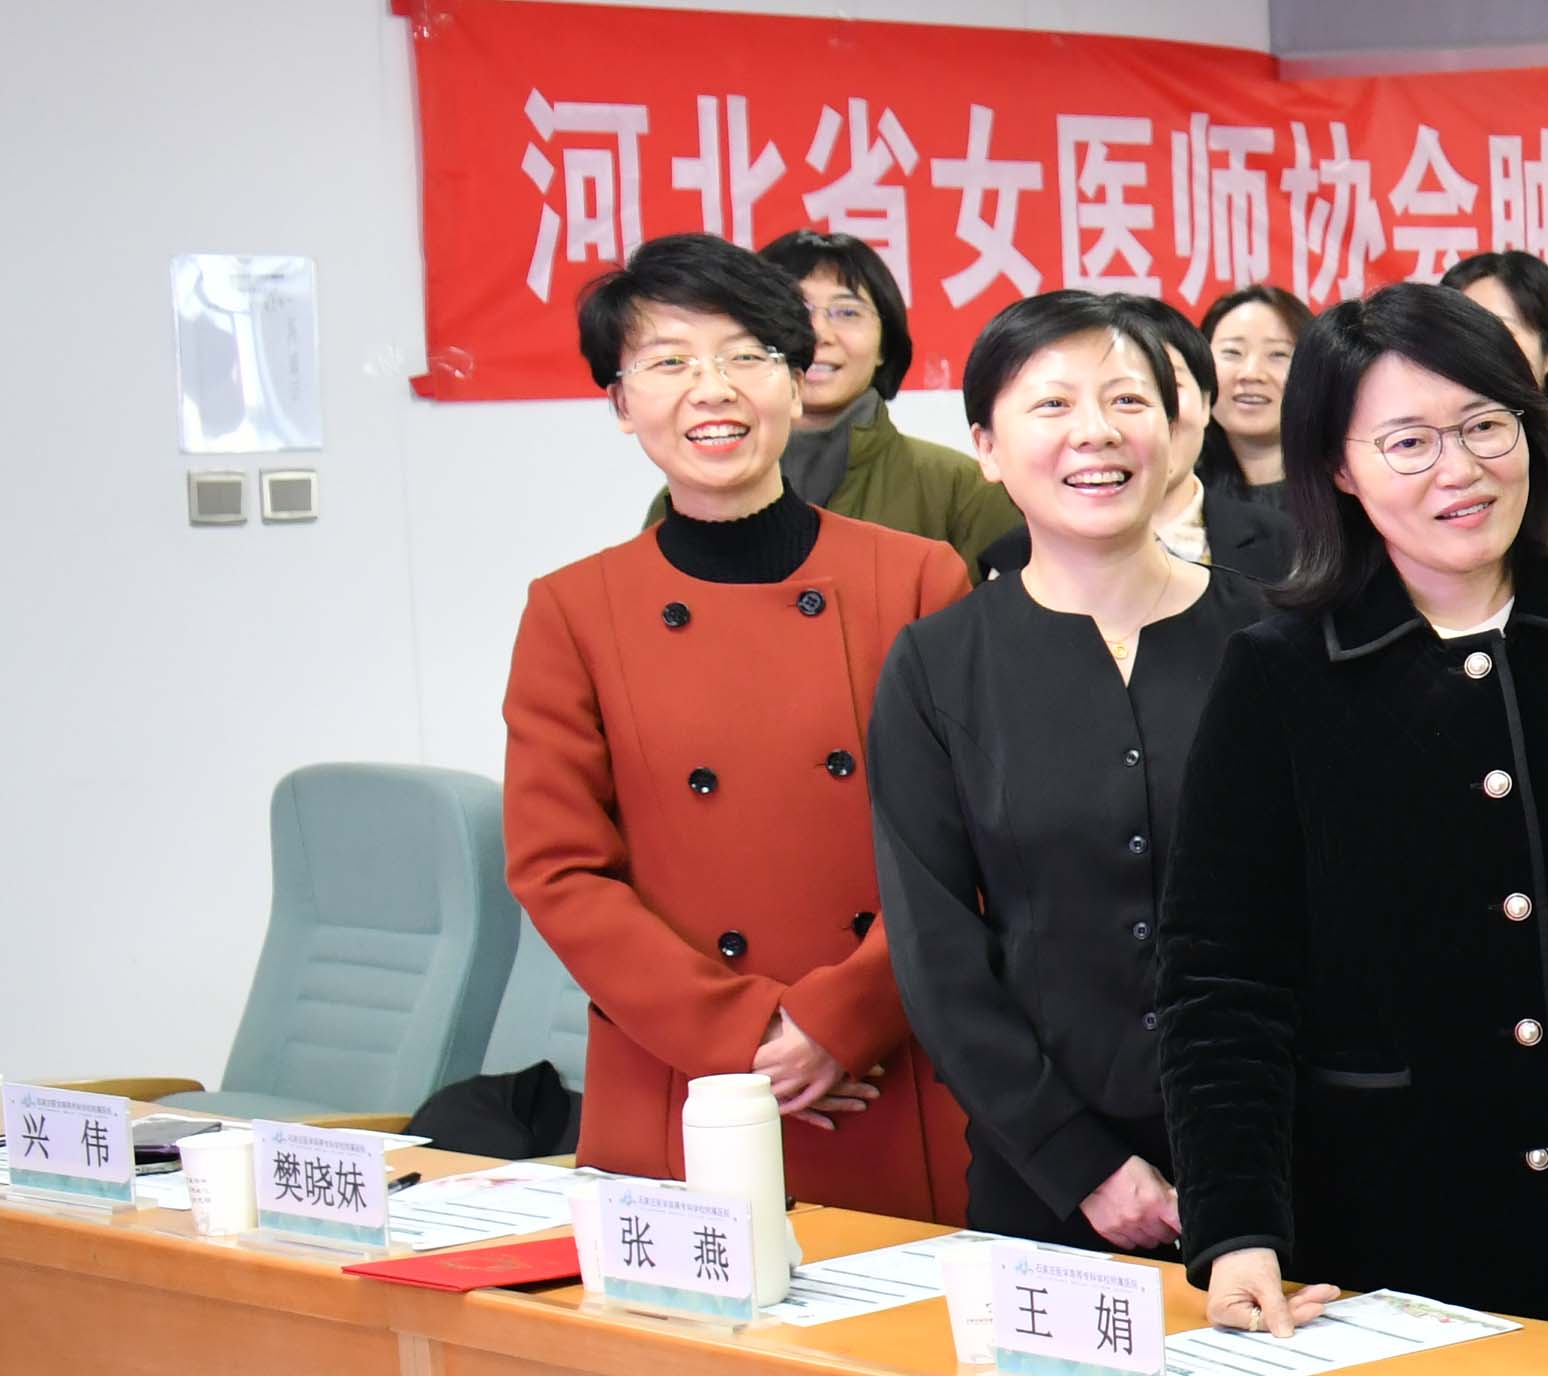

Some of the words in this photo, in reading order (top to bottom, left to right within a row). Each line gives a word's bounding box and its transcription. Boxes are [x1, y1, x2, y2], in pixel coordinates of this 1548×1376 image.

[273, 1150, 367, 1213] 樊晓妹
[619, 1215, 731, 1284] 张燕
[1014, 1285, 1134, 1356] 王娟
